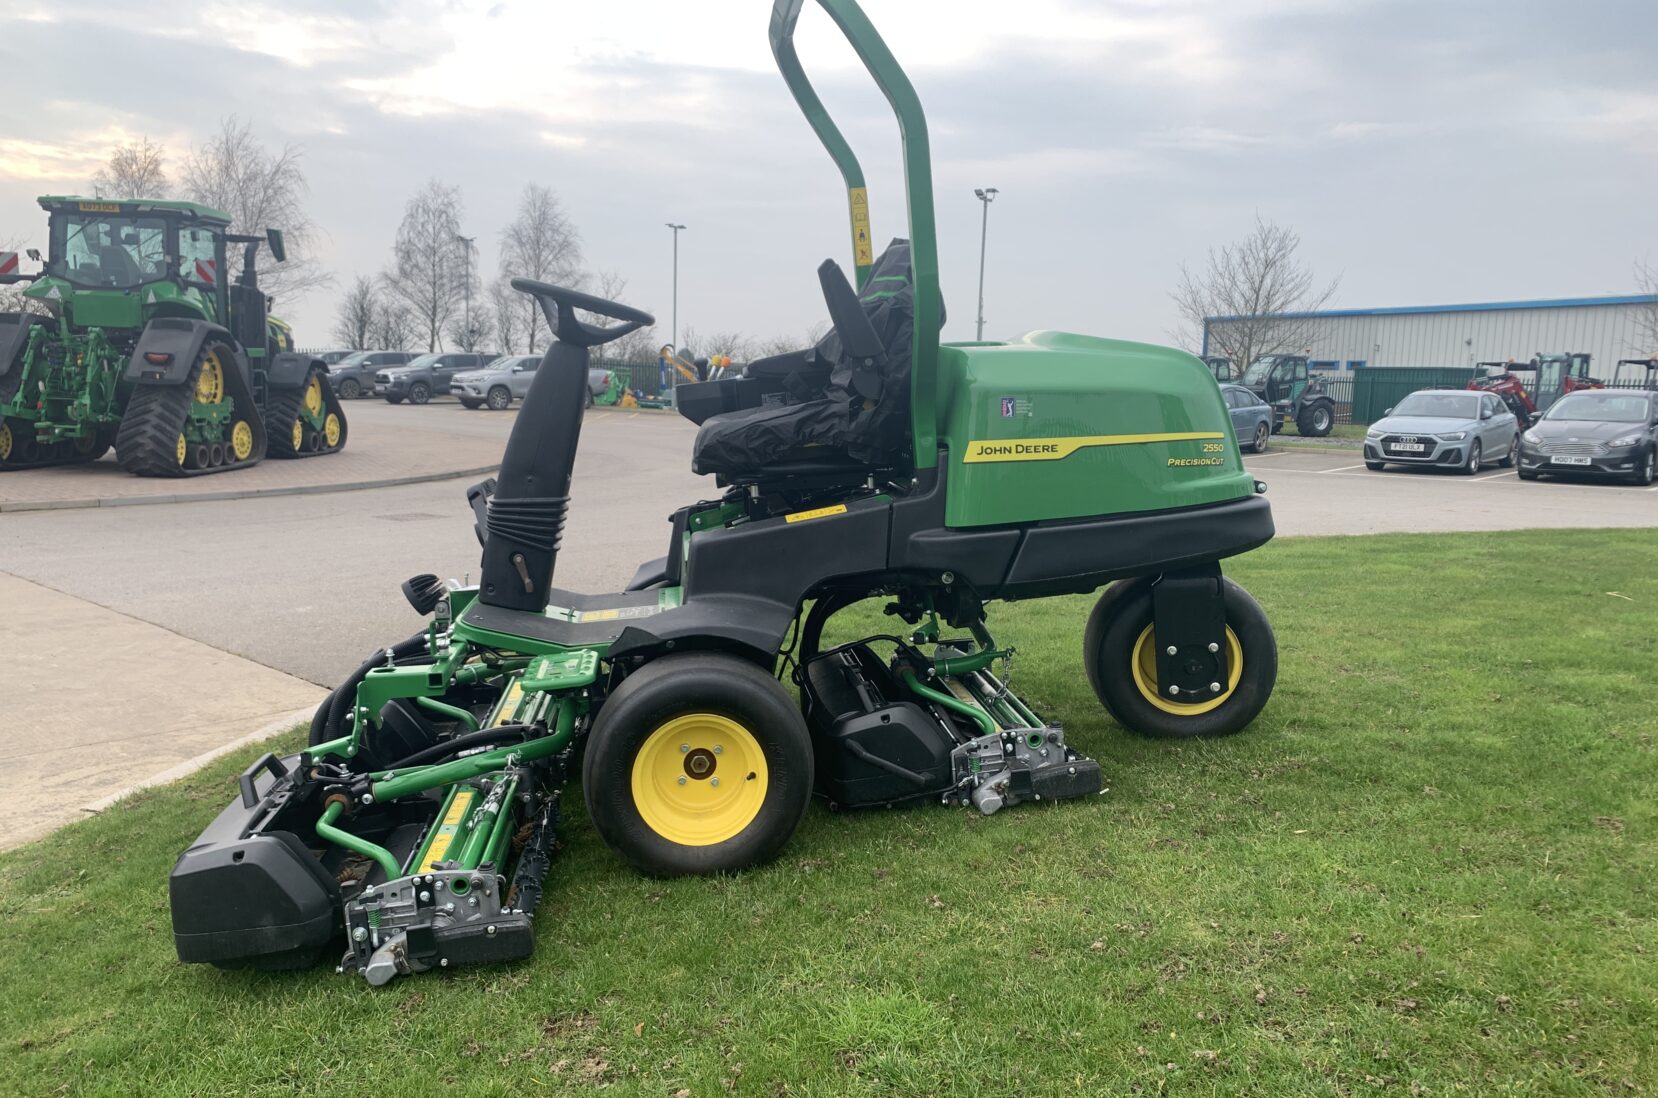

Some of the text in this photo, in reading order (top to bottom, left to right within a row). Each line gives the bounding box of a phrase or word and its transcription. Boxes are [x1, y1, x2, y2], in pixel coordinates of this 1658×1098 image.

[976, 444, 1059, 456] JOHN DEERE
[1203, 443, 1224, 452] 2550
